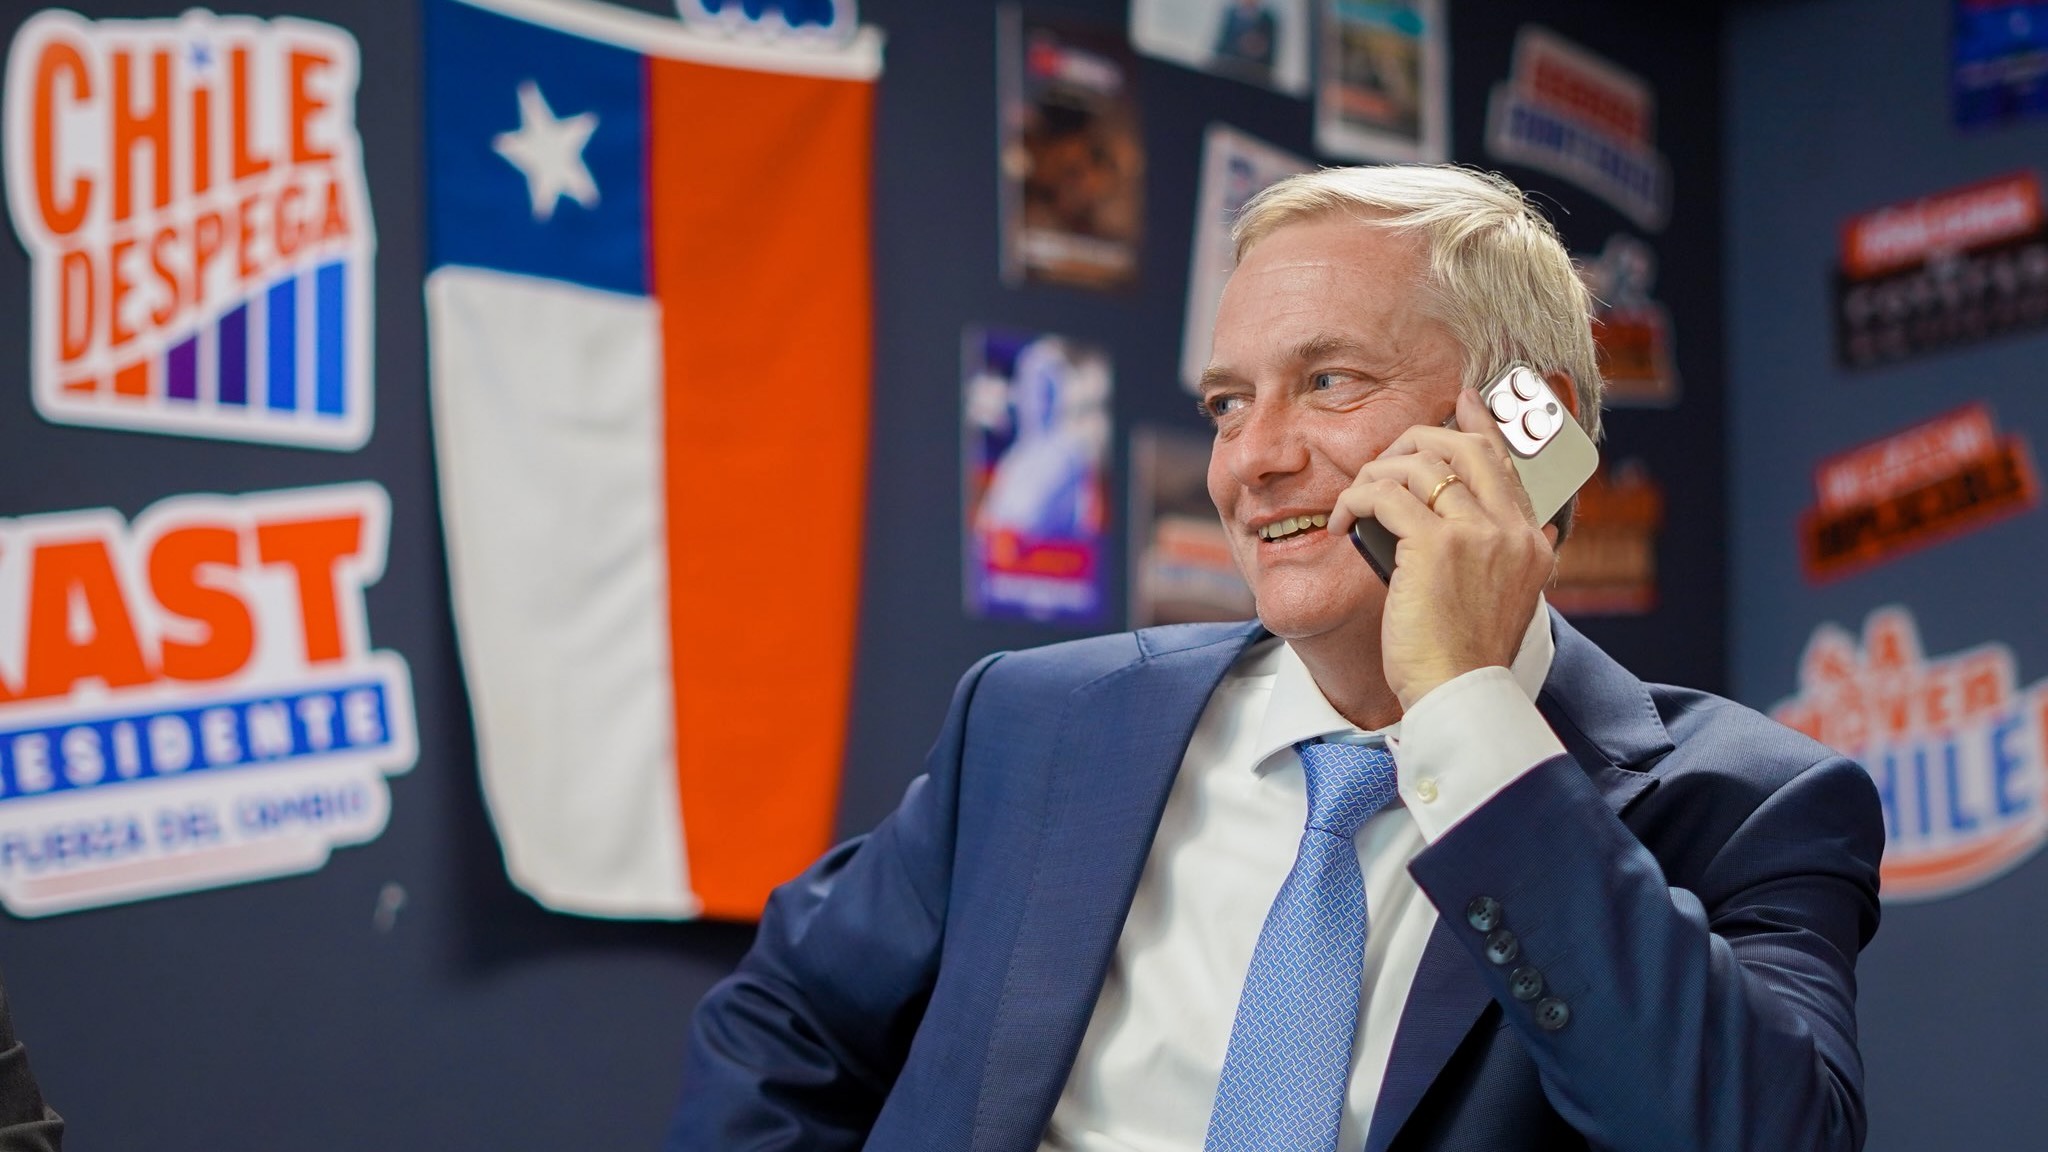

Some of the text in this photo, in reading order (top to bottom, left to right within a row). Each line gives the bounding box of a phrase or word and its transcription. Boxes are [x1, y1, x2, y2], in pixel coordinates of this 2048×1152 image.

[60, 177, 349, 362] DESPEGA
[0, 514, 364, 704] AST
[0, 688, 385, 795] ESIDENTE
[1857, 711, 2031, 840] HILE
[1, 816, 146, 870] FUERZA
[156, 806, 220, 843] DEL
